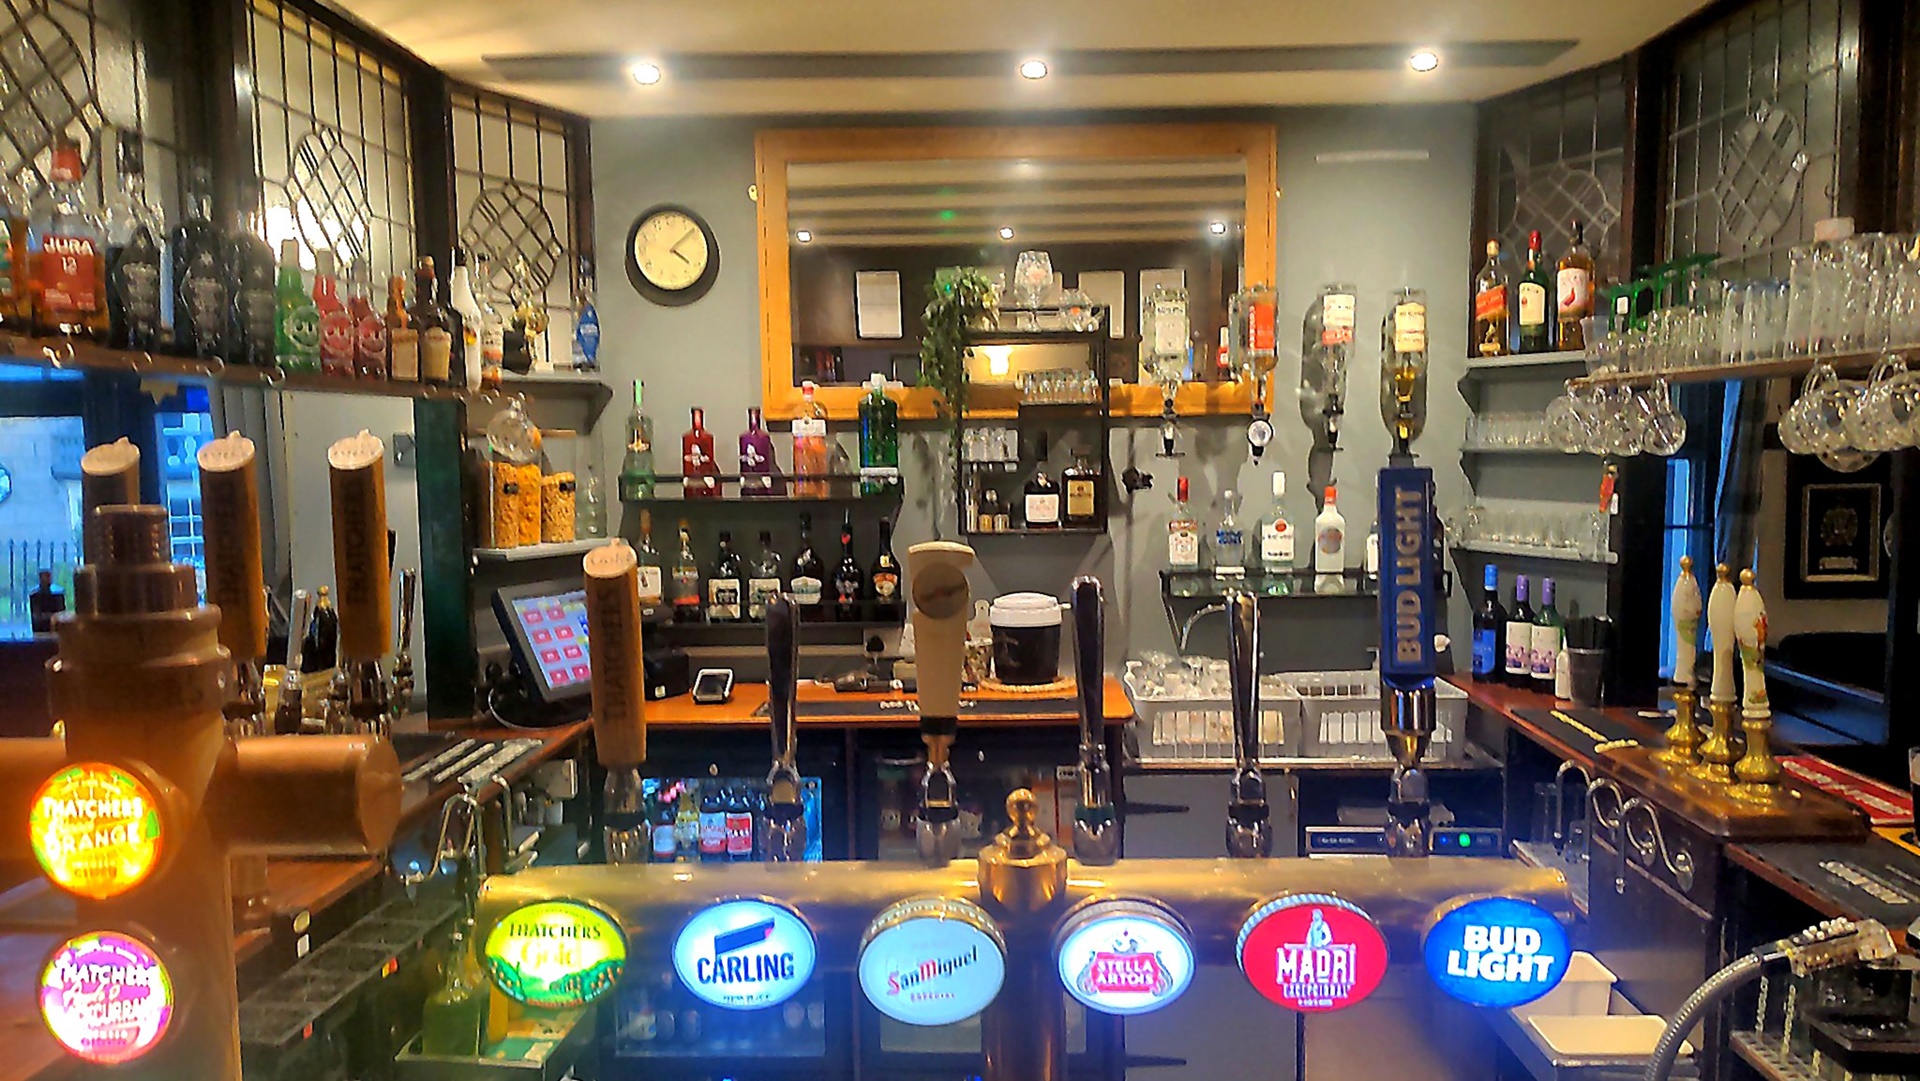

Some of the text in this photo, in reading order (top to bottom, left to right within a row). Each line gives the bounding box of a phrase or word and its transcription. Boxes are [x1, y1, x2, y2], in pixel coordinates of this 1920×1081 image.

[44, 236, 94, 256] JURA
[1396, 487, 1421, 662] BUD LIGHT
[42, 796, 143, 818] THATCHERS
[45, 821, 140, 861] ORANGE
[510, 922, 602, 939] THATCHERS
[1463, 925, 1542, 955] BUD
[698, 949, 795, 985] CARLING
[1096, 959, 1151, 974] STELLA
[1447, 951, 1555, 983] LIGHT
